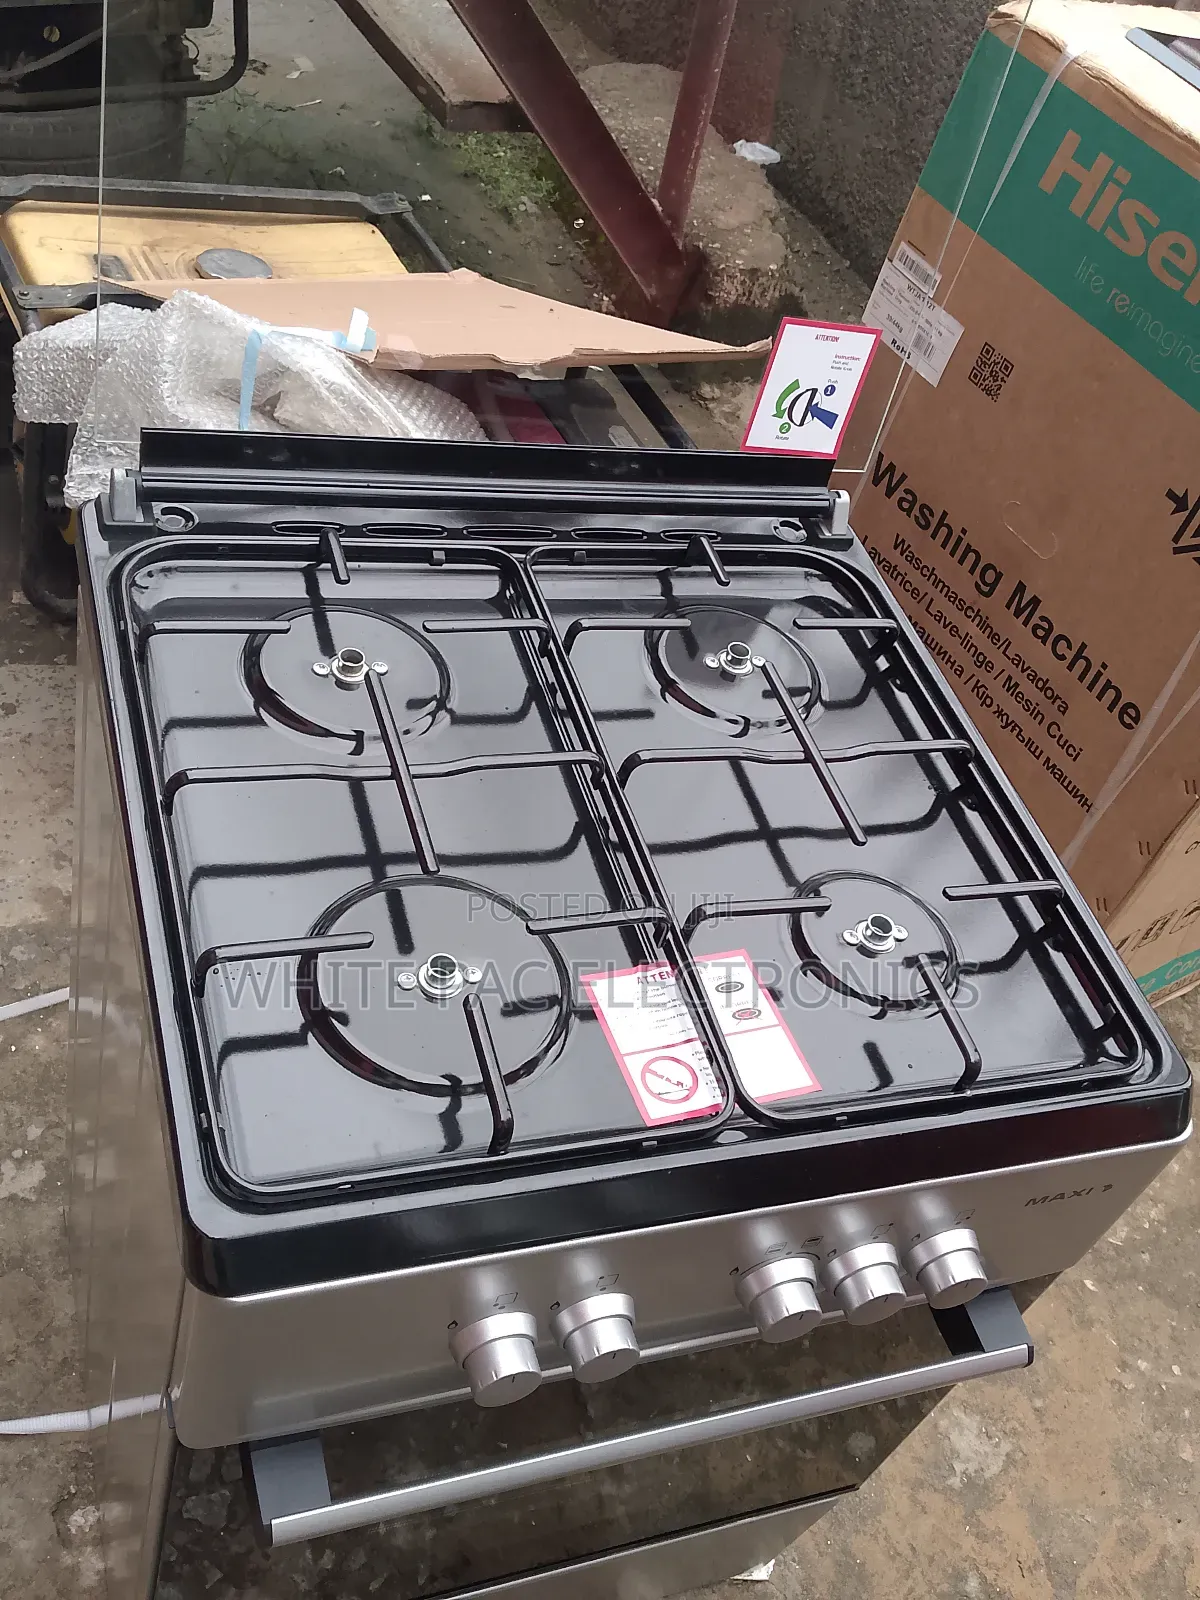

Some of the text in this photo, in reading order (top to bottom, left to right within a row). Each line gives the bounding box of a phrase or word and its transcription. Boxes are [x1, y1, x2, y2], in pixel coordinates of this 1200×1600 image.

[1074, 255, 1105, 294] life
[871, 451, 1142, 731] Washing Machine
[925, 597, 995, 673] Lave-linge
[1001, 674, 1045, 726] Mesin
[1046, 720, 1084, 762] Cuci
[1024, 1186, 1094, 1207] MAXI
